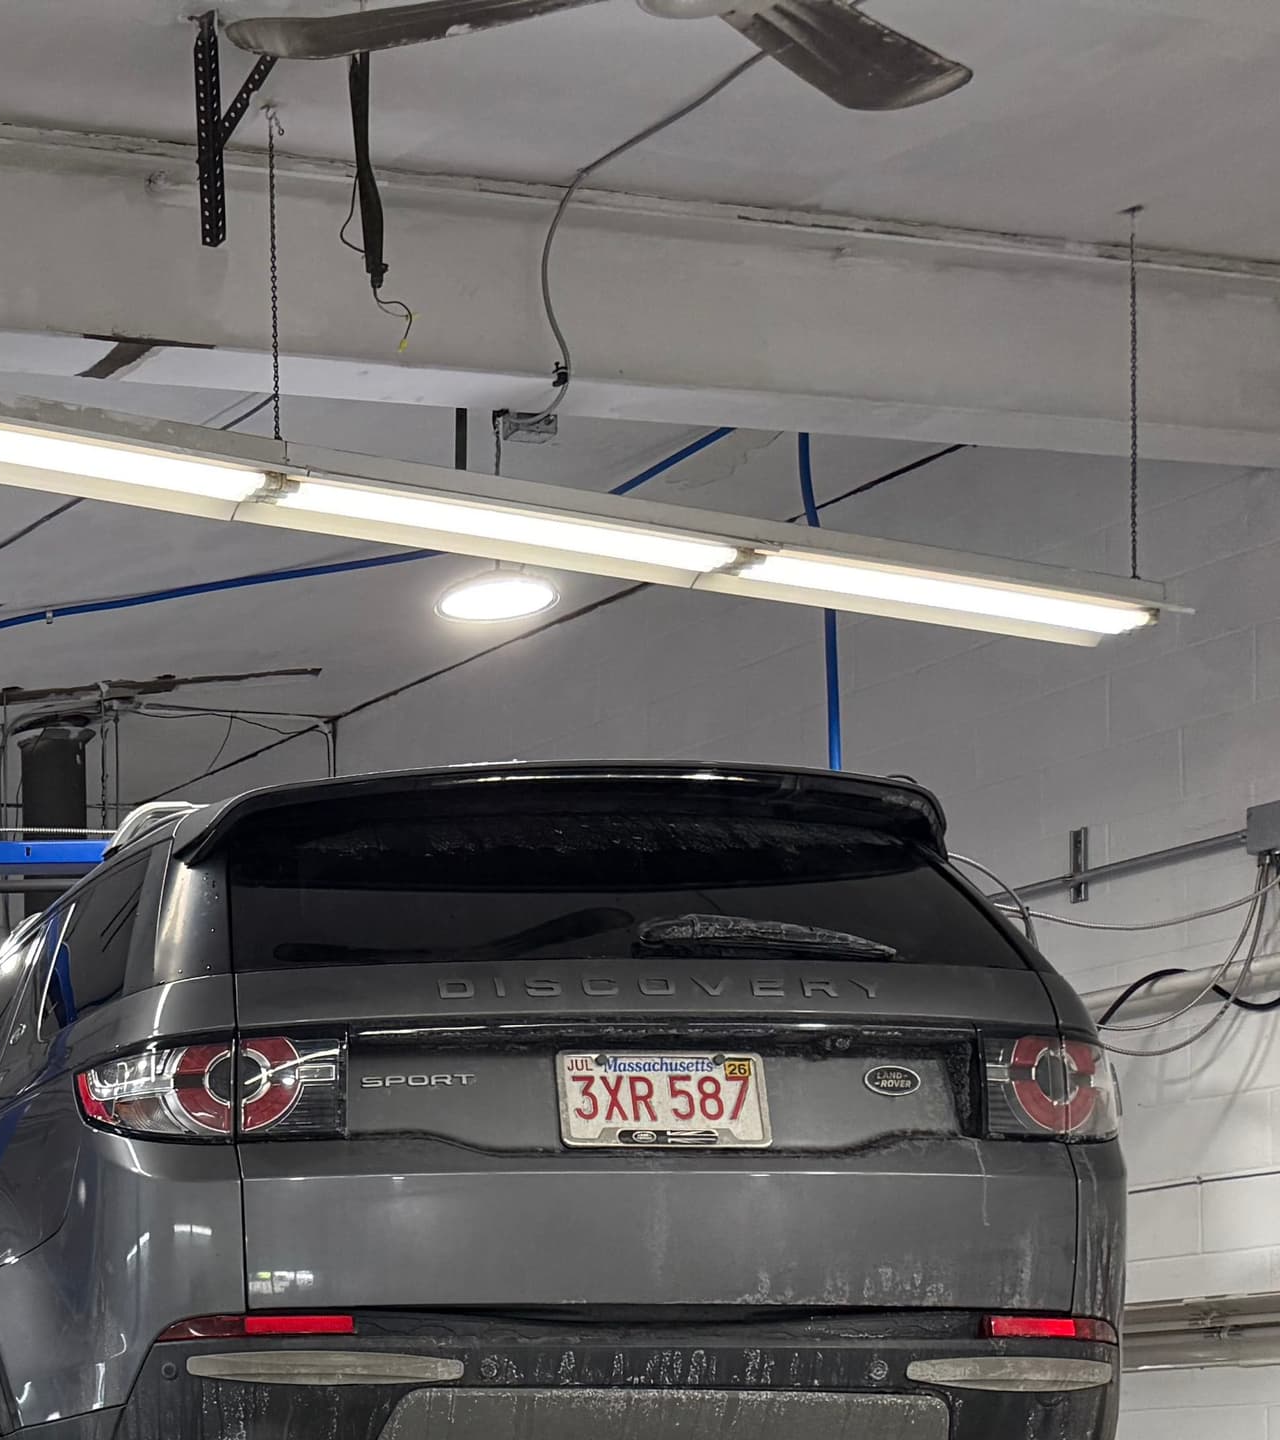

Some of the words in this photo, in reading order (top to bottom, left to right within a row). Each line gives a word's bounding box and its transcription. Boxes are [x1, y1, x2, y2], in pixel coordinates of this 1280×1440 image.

[438, 976, 879, 999] DISCOVERY
[568, 1059, 593, 1071] JUL
[604, 1057, 713, 1073] Massachusetts
[728, 1063, 746, 1075] 26
[361, 1074, 475, 1087] SPORT
[572, 1075, 657, 1121] 3XR
[669, 1075, 750, 1121] 587
